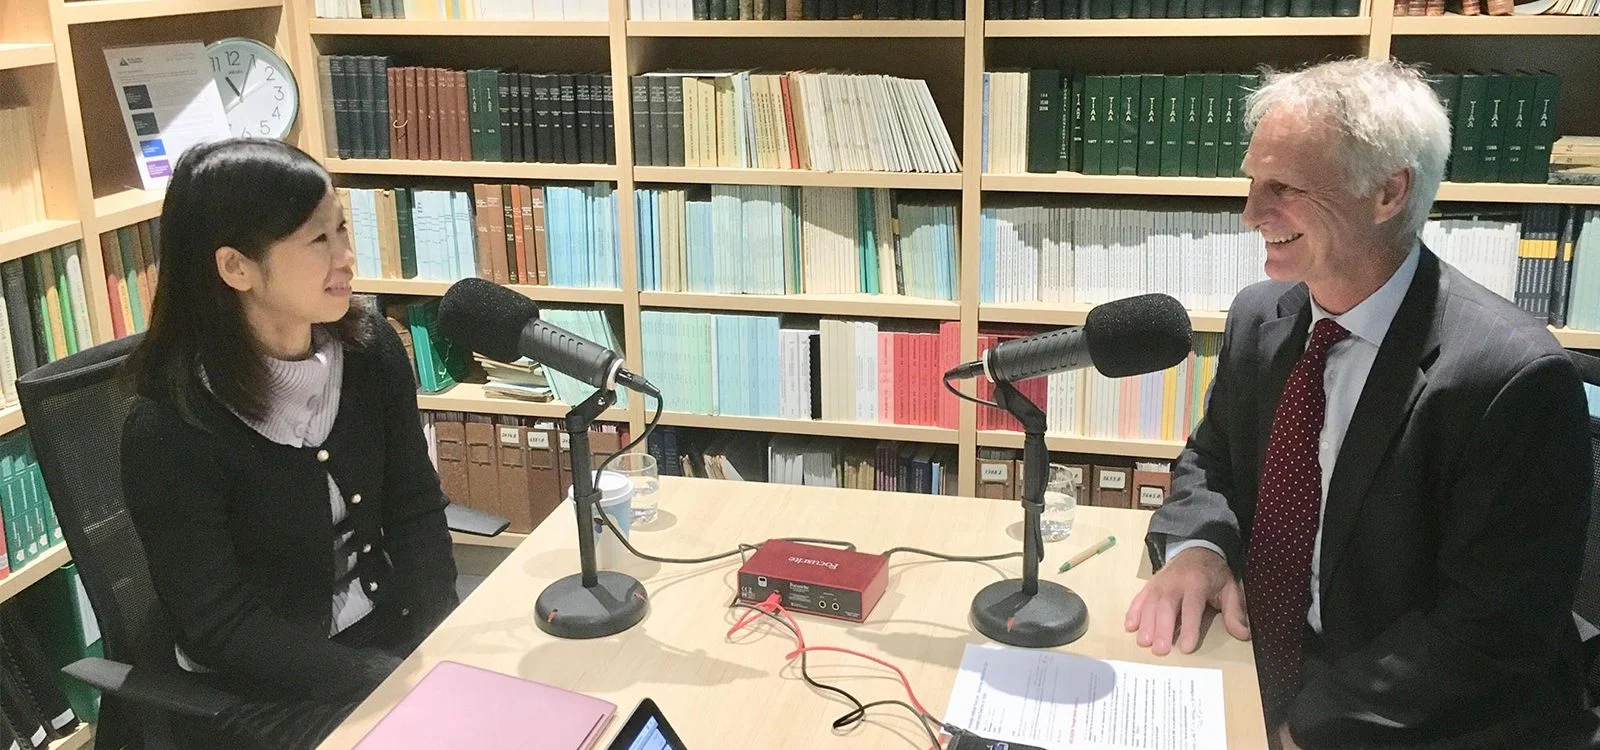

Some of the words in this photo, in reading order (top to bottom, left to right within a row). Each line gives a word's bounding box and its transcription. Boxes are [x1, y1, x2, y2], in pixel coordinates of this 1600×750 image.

[210, 57, 221, 72] 11
[225, 51, 241, 66] 12
[264, 66, 276, 81] 2
[273, 86, 285, 101] 3
[272, 106, 281, 120] 4
[1169, 97, 1177, 122] TIAA
[1207, 98, 1215, 123] TIAA
[1225, 98, 1233, 123] TIAA
[1467, 101, 1476, 128] TIAA
[1491, 99, 1501, 128] TIAA
[1515, 100, 1525, 128] TIAA
[1540, 99, 1550, 127] TIAA
[259, 120, 271, 135] 5
[788, 556, 840, 570] Focusrite
